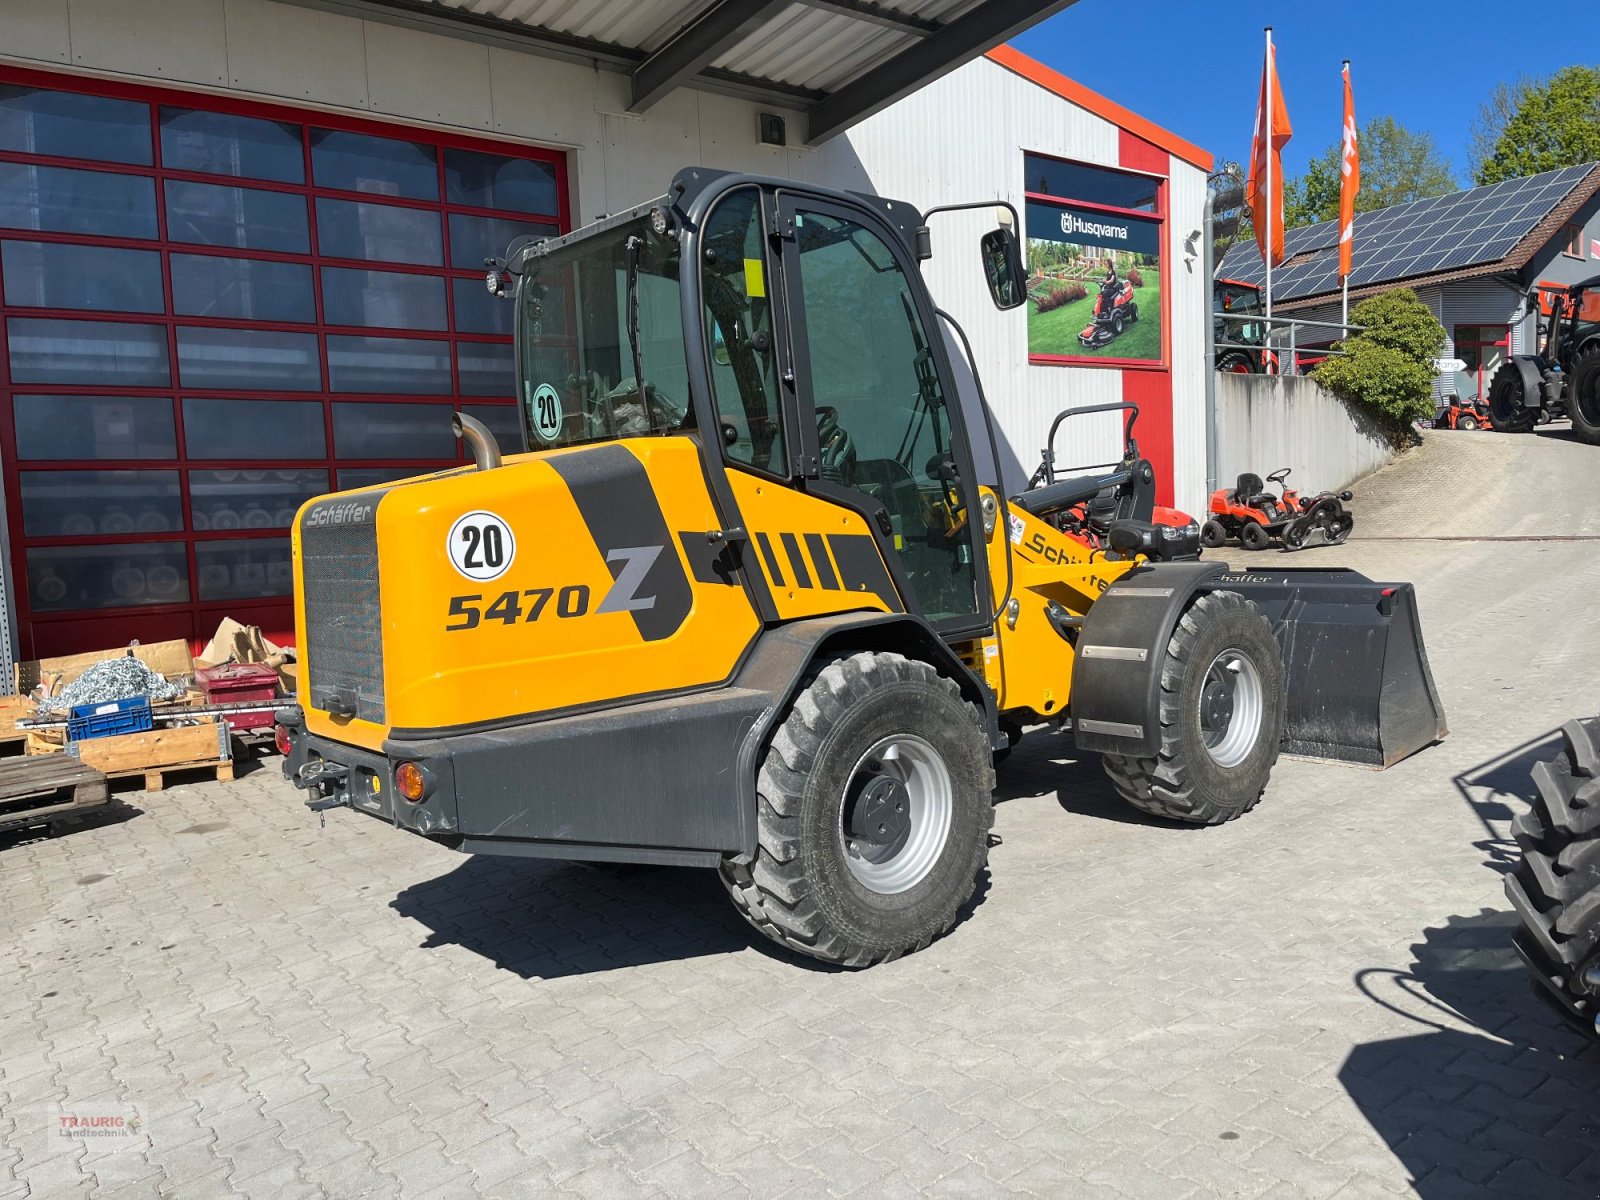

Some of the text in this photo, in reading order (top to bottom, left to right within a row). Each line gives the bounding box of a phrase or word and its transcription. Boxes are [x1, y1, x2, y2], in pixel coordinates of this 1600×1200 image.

[1073, 216, 1127, 240] Husqvarna
[538, 394, 557, 429] 20
[306, 503, 371, 527] Schäffer
[462, 524, 504, 569] 20
[446, 545, 665, 632] 5470 Z
[1211, 574, 1273, 583] chäffer
